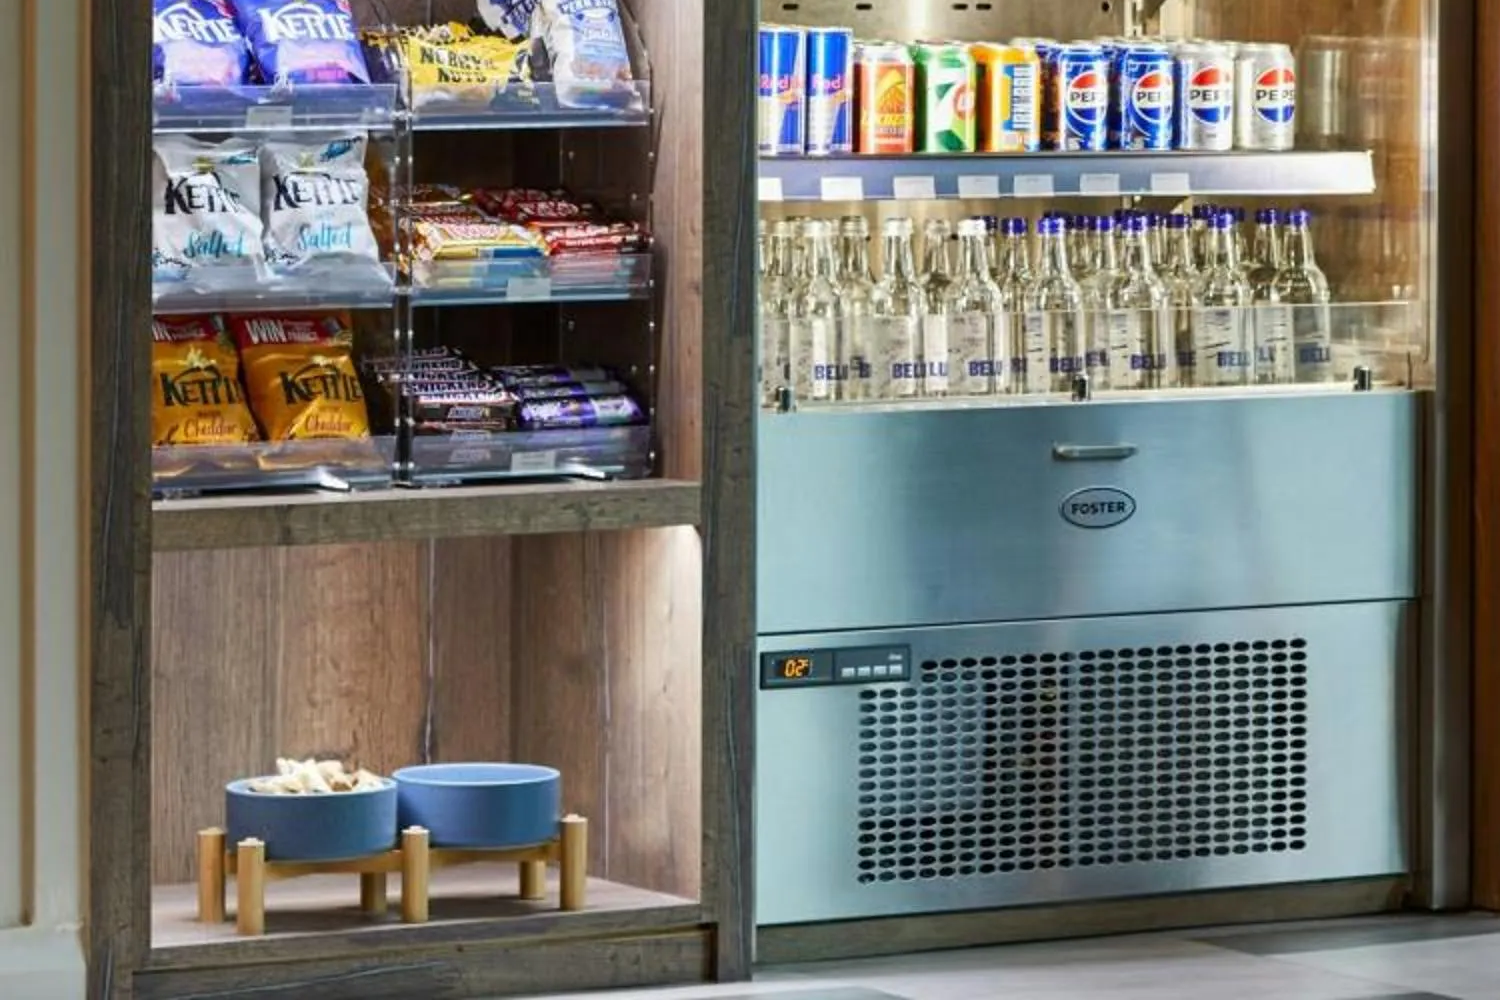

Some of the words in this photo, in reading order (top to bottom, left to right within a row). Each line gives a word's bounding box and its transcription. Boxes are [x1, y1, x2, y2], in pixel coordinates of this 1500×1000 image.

[258, 3, 356, 44] KETTLE
[298, 222, 354, 249] Salted
[245, 318, 287, 344] WIN
[1071, 501, 1125, 515] FOSTER
